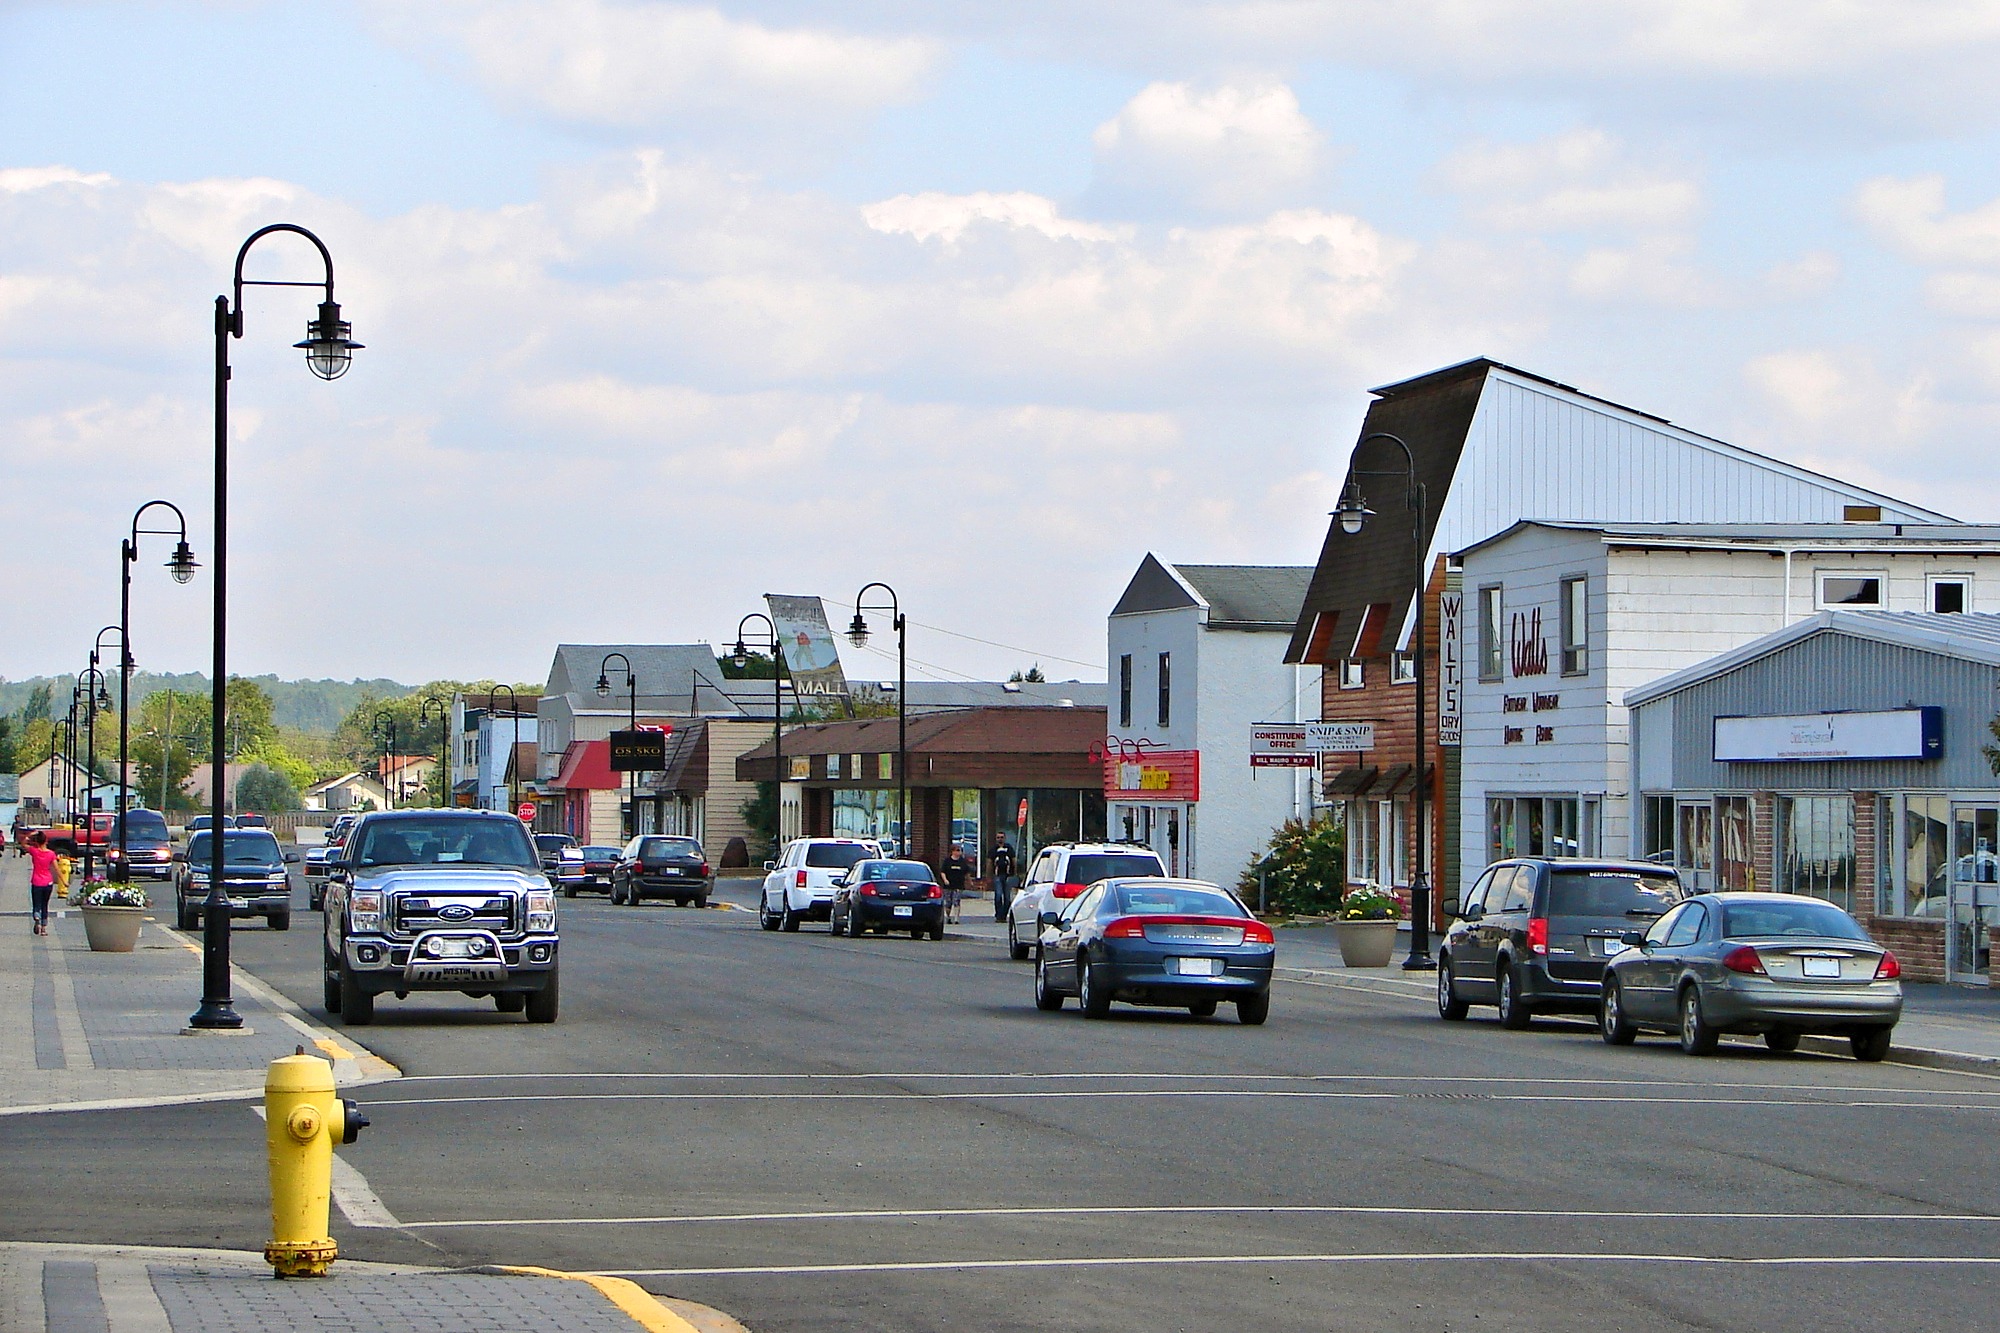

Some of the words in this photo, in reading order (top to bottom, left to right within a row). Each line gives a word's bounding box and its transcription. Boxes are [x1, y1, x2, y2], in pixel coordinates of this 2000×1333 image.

[797, 680, 848, 695] MALL
[1441, 715, 1459, 729] DRY
[1254, 732, 1306, 740] CONSTITUENC
[1309, 727, 1335, 736] SNIP
[1344, 726, 1370, 735] SNIP
[520, 808, 535, 816] STOP
